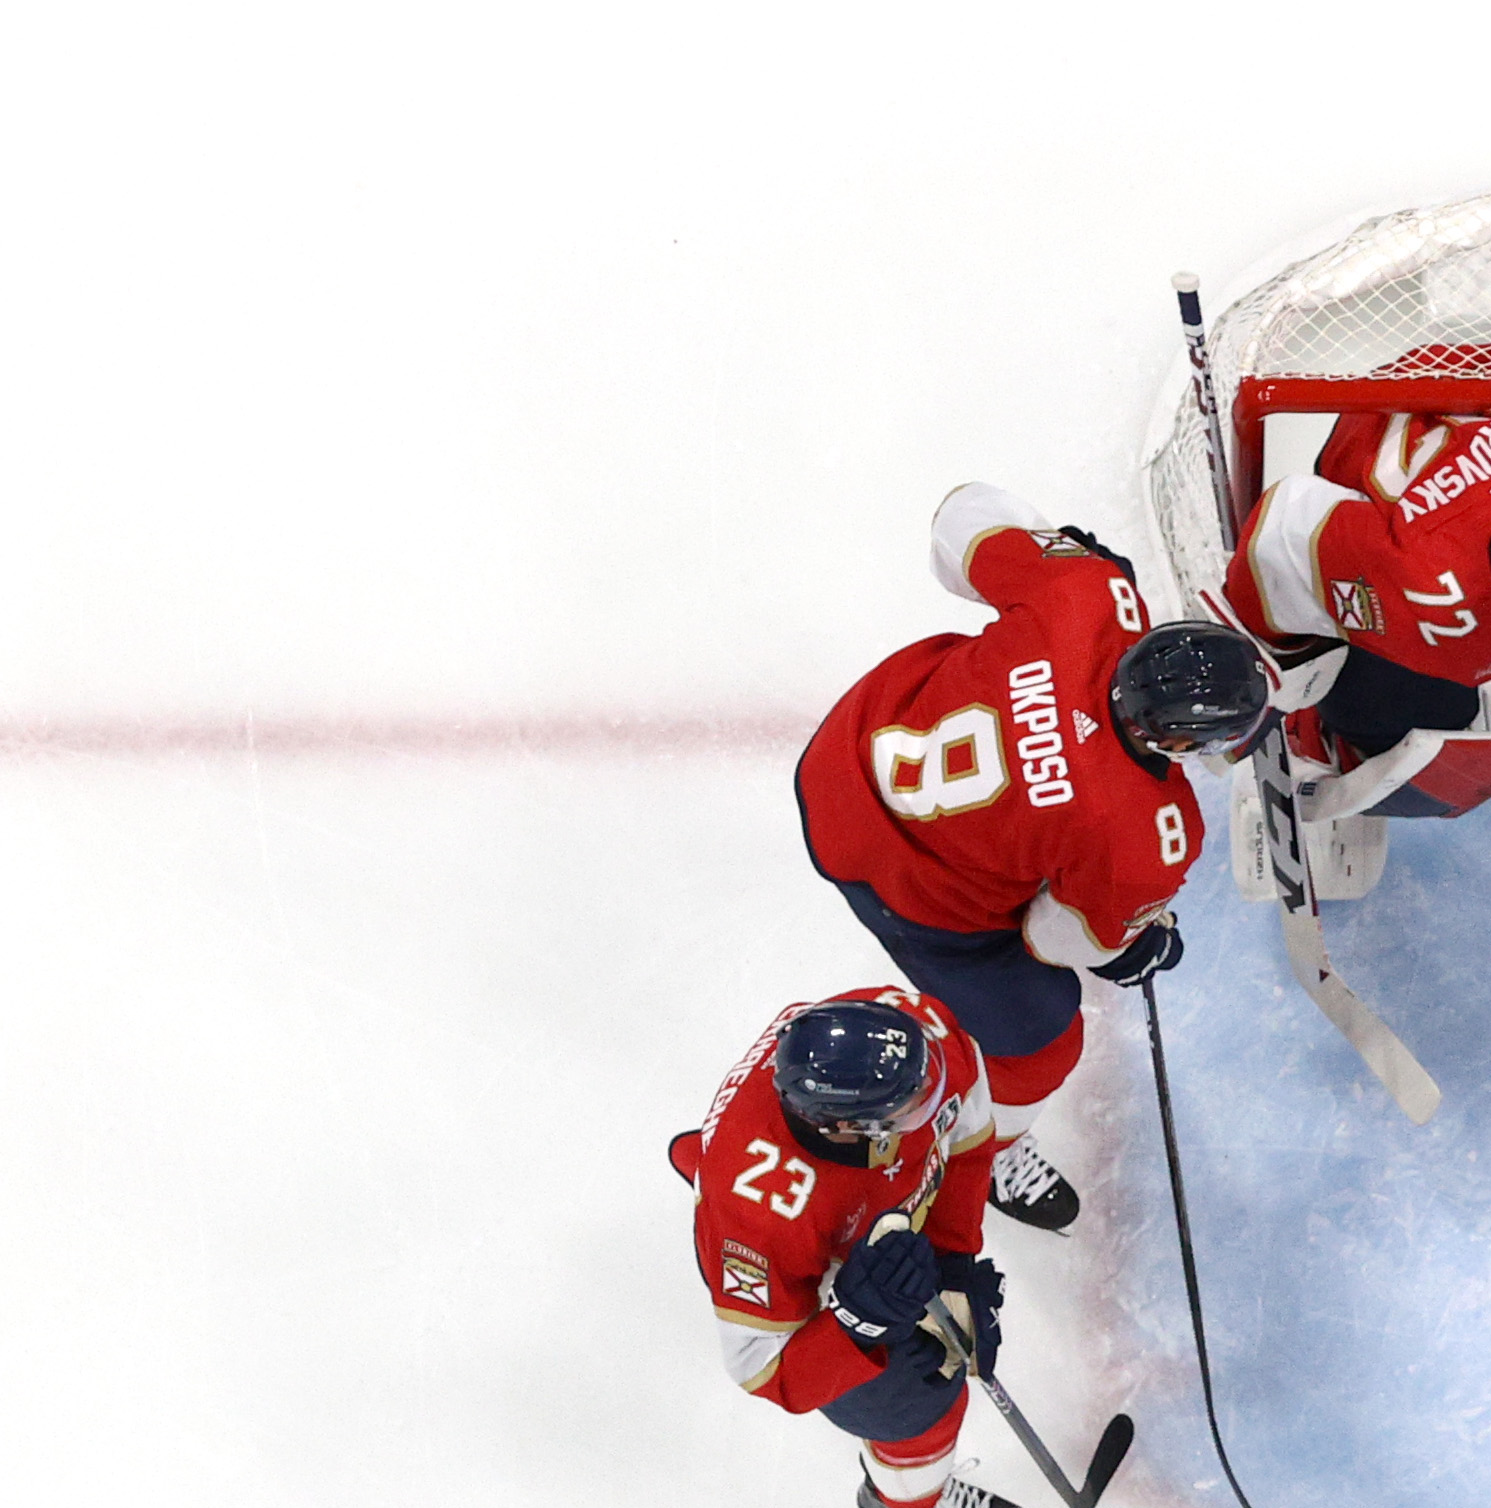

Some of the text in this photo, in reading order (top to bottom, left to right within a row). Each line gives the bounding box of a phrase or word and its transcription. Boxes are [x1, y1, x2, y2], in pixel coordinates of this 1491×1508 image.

[1109, 577, 1142, 633] 8
[1403, 570, 1479, 646] 72
[871, 702, 1011, 822] 8
[1009, 659, 1074, 808] OKPOSO
[1154, 802, 1189, 867] 8
[885, 1028, 908, 1060] 23
[731, 1138, 818, 1221] 23
